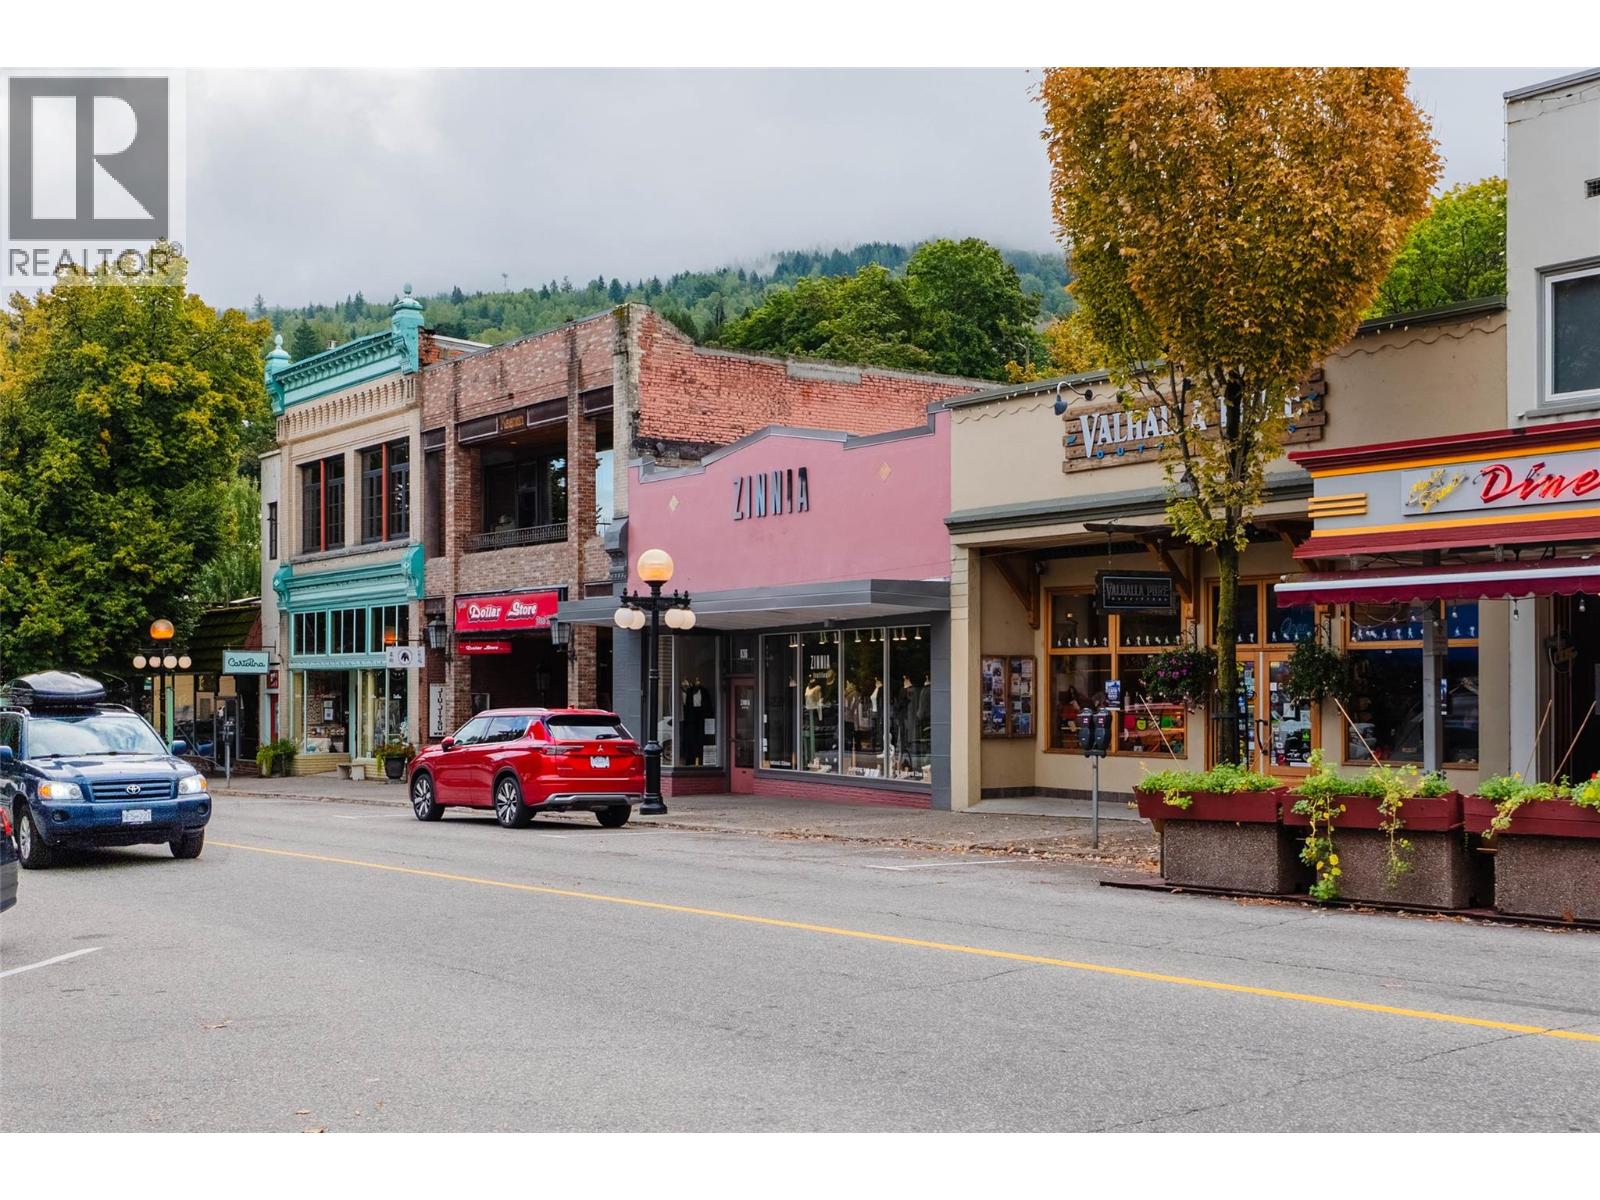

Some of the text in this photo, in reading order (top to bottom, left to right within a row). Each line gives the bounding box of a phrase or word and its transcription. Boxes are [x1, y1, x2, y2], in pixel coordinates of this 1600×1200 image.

[1079, 399, 1208, 459] VALHALA
[732, 466, 810, 521] ZINNIA
[468, 603, 502, 622] Dollar
[506, 599, 538, 620] Store
[228, 657, 266, 668] Cartolina
